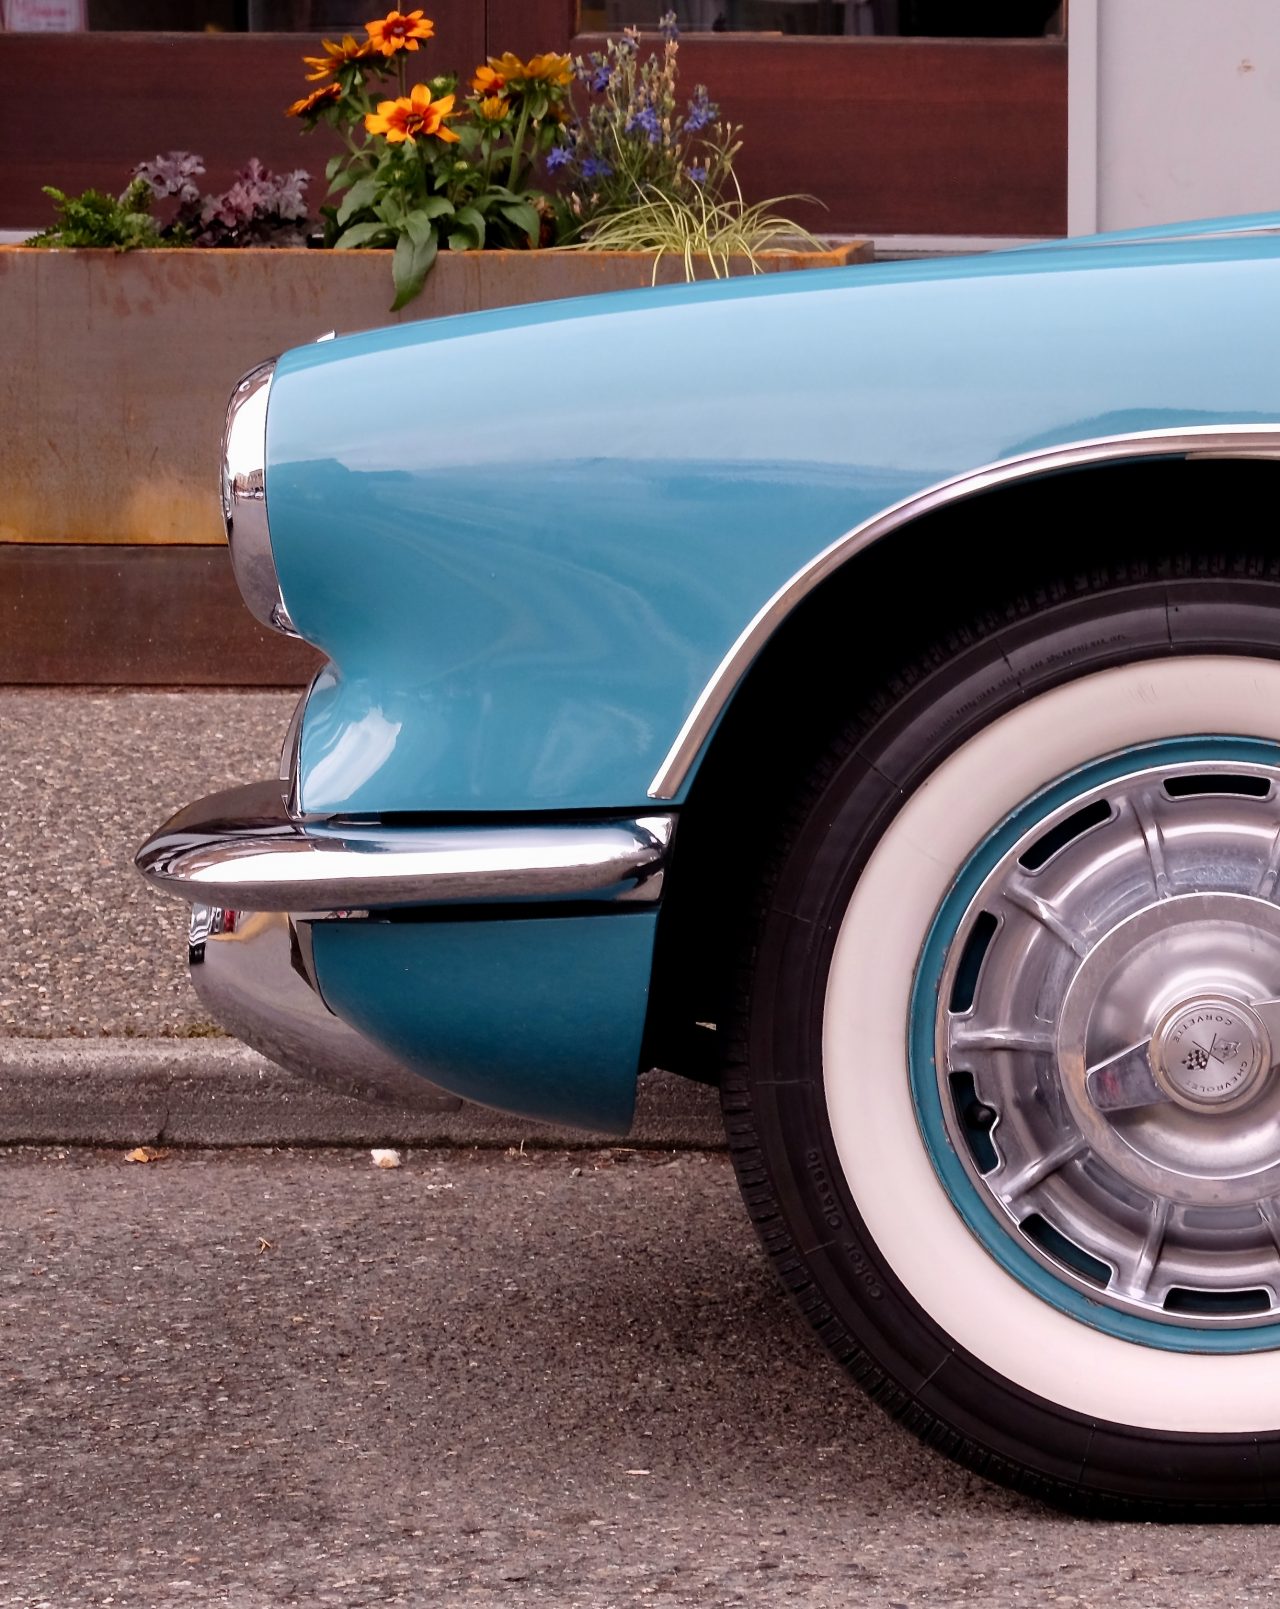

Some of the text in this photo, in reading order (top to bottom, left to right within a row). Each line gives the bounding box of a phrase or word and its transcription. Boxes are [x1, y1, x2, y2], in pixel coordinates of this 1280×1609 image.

[1174, 1014, 1233, 1043] CORVETTE
[1186, 1060, 1248, 1093] CHEVROLET
[806, 1147, 884, 1301] Coker Classic
